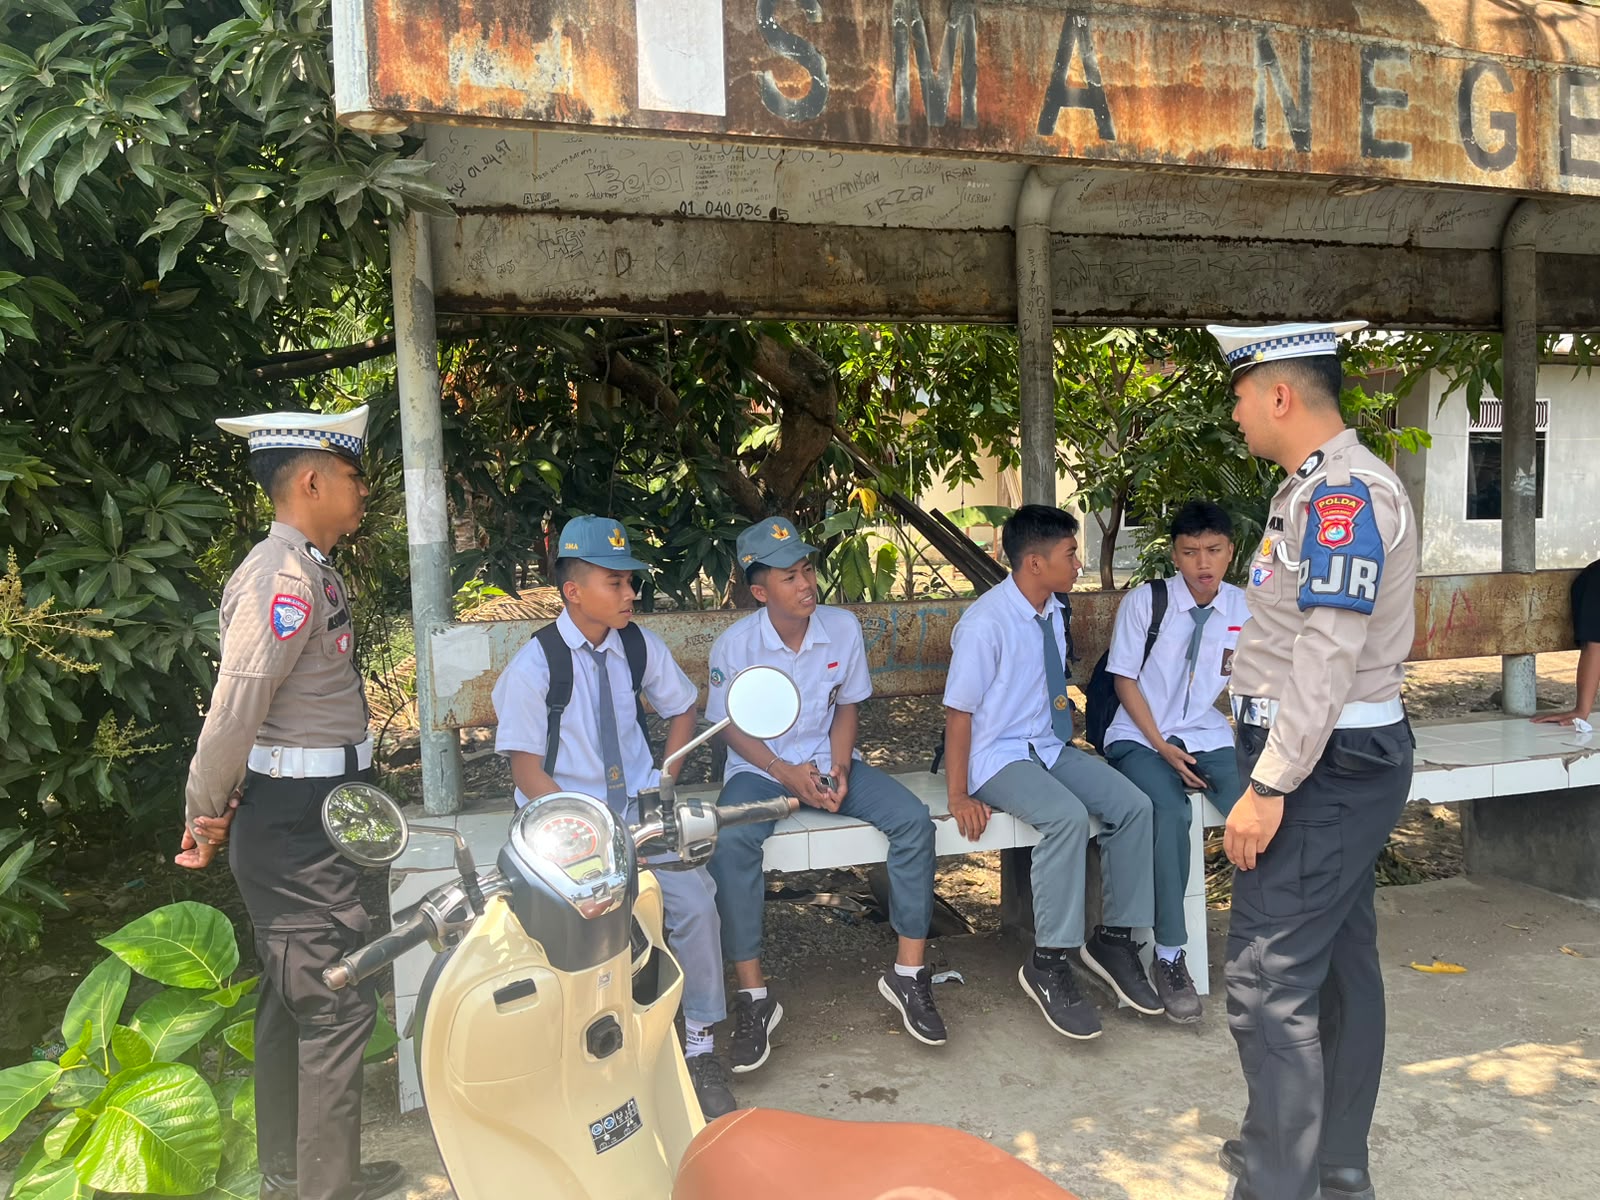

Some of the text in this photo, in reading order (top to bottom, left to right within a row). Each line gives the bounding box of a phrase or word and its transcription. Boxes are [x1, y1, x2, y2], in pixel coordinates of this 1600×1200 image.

[756, 0, 1116, 141] SMA
[1318, 497, 1357, 509] POLDA
[564, 542, 579, 551] SMA
